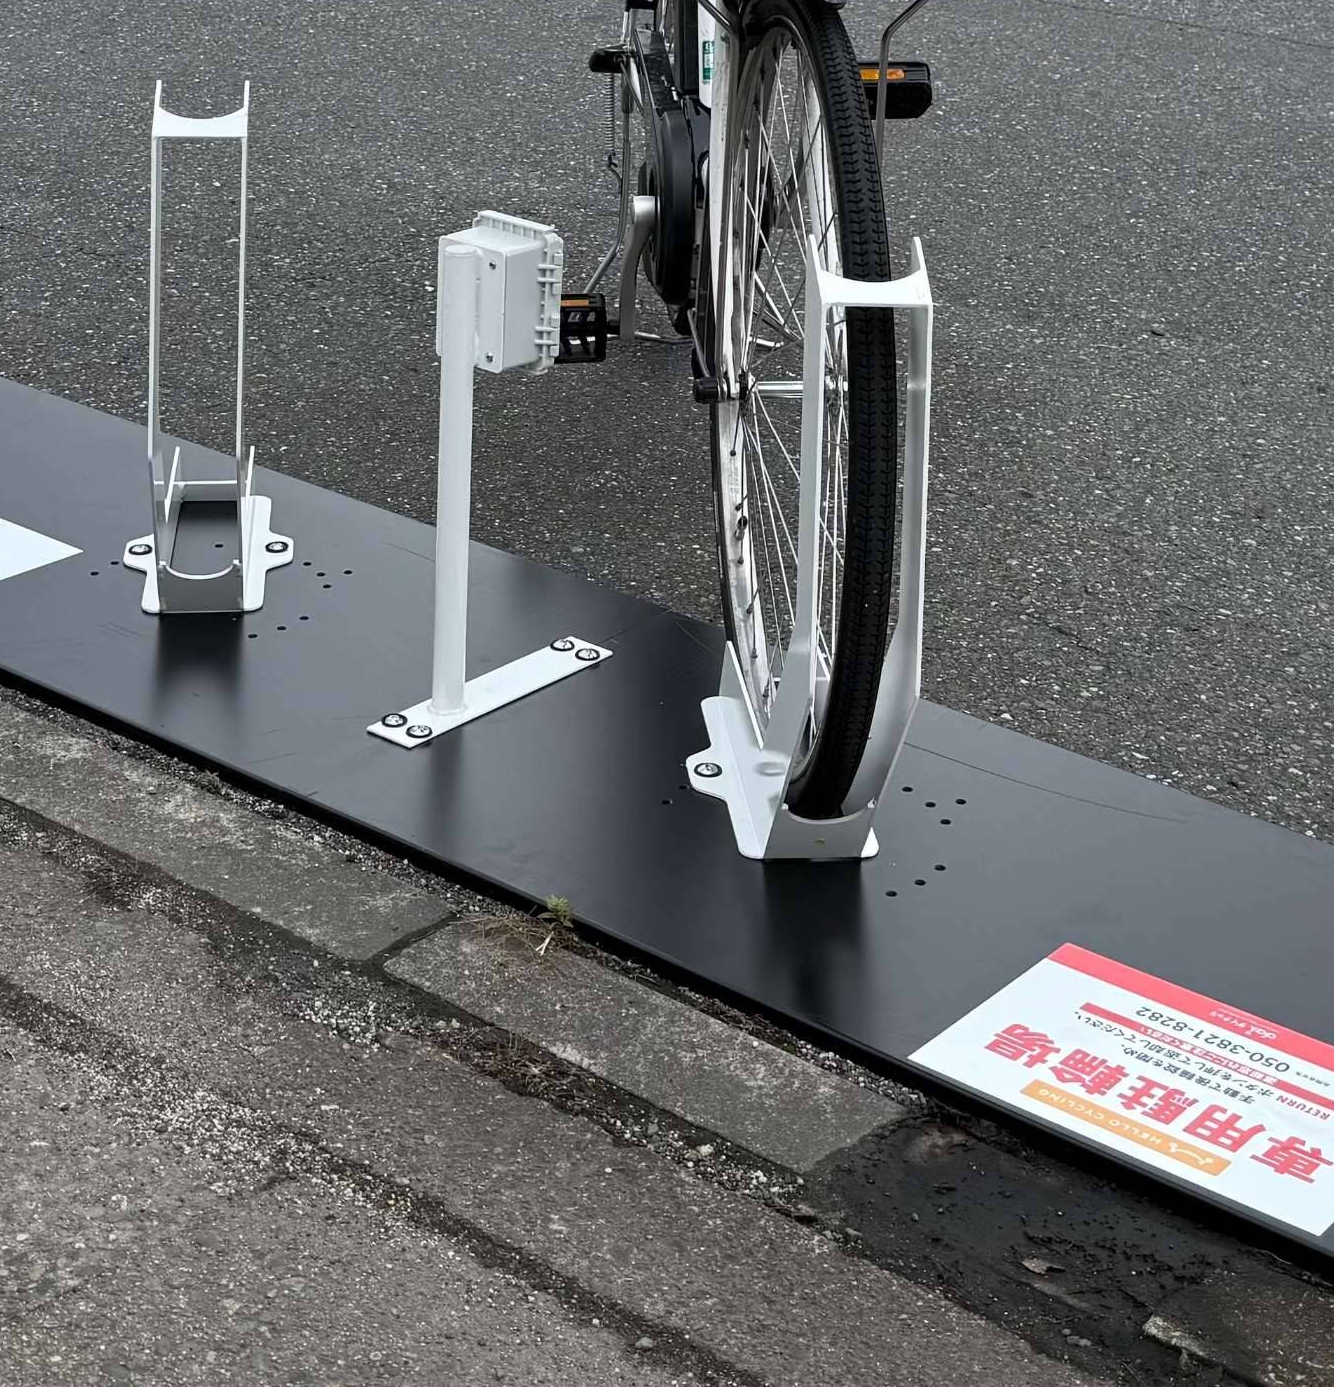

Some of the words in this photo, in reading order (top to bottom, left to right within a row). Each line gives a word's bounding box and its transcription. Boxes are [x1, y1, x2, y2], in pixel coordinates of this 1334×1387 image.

[1135, 1006, 1292, 1073] 050-3821-8282
[982, 1023, 1334, 1184] 専用駐輪場
[1037, 1086, 1108, 1120] CYCLING
[1275, 1095, 1332, 1120] RETURN
[1107, 1119, 1163, 1144] HELLO
